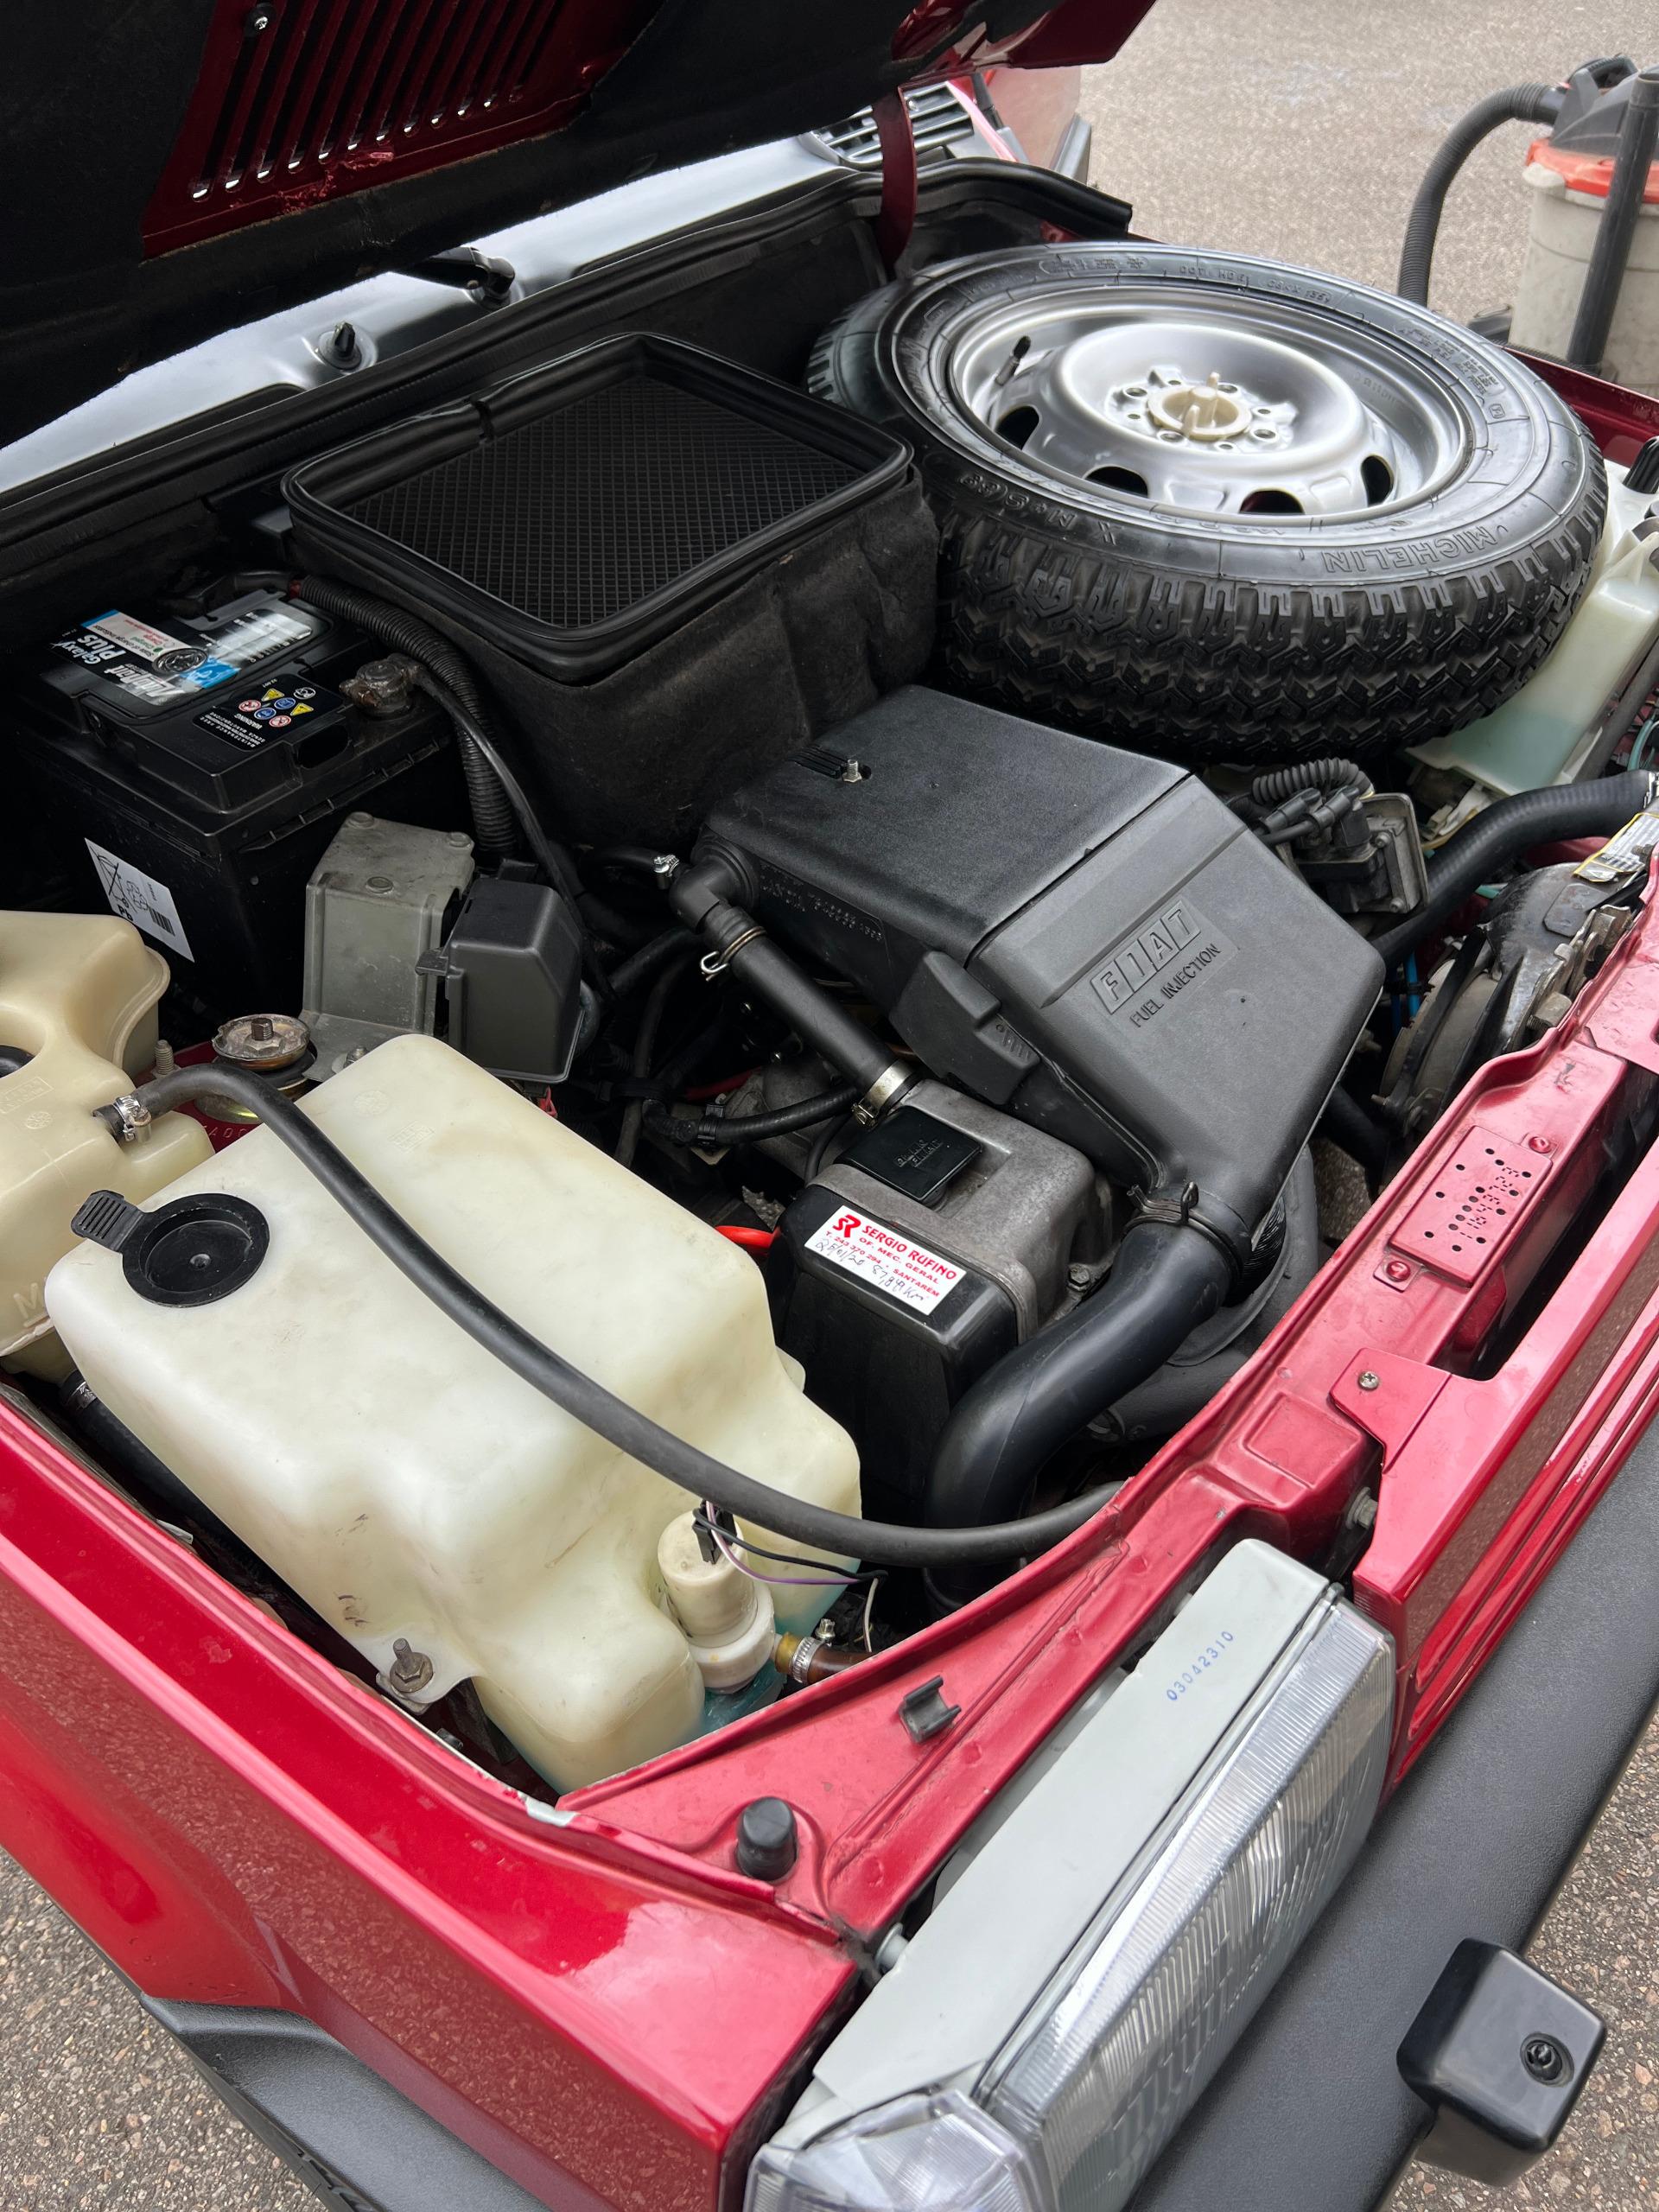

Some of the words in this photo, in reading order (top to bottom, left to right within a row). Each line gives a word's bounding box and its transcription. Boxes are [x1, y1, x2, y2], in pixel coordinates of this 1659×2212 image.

[1321, 525, 1497, 573] MICHELIN
[55, 640, 101, 664] Galaxy
[77, 634, 127, 661] Plus
[233, 713, 263, 730] WARNING
[1099, 908, 1192, 1002] FIAT
[1129, 999, 1165, 1028] FUEL
[1160, 944, 1222, 1000] INJECTION
[834, 1236, 849, 1247] 243
[849, 1244, 866, 1255] 370
[866, 1254, 882, 1264] 294
[893, 1268, 941, 1297] SANTARÉM
[859, 1236, 874, 1249] OF.
[877, 1247, 901, 1264] MEC.
[906, 1262, 939, 1284] GERAL
[861, 1225, 907, 1253] SERGIO
[908, 1249, 957, 1280] RUFINO
[1166, 1631, 1234, 1700] 03042310
